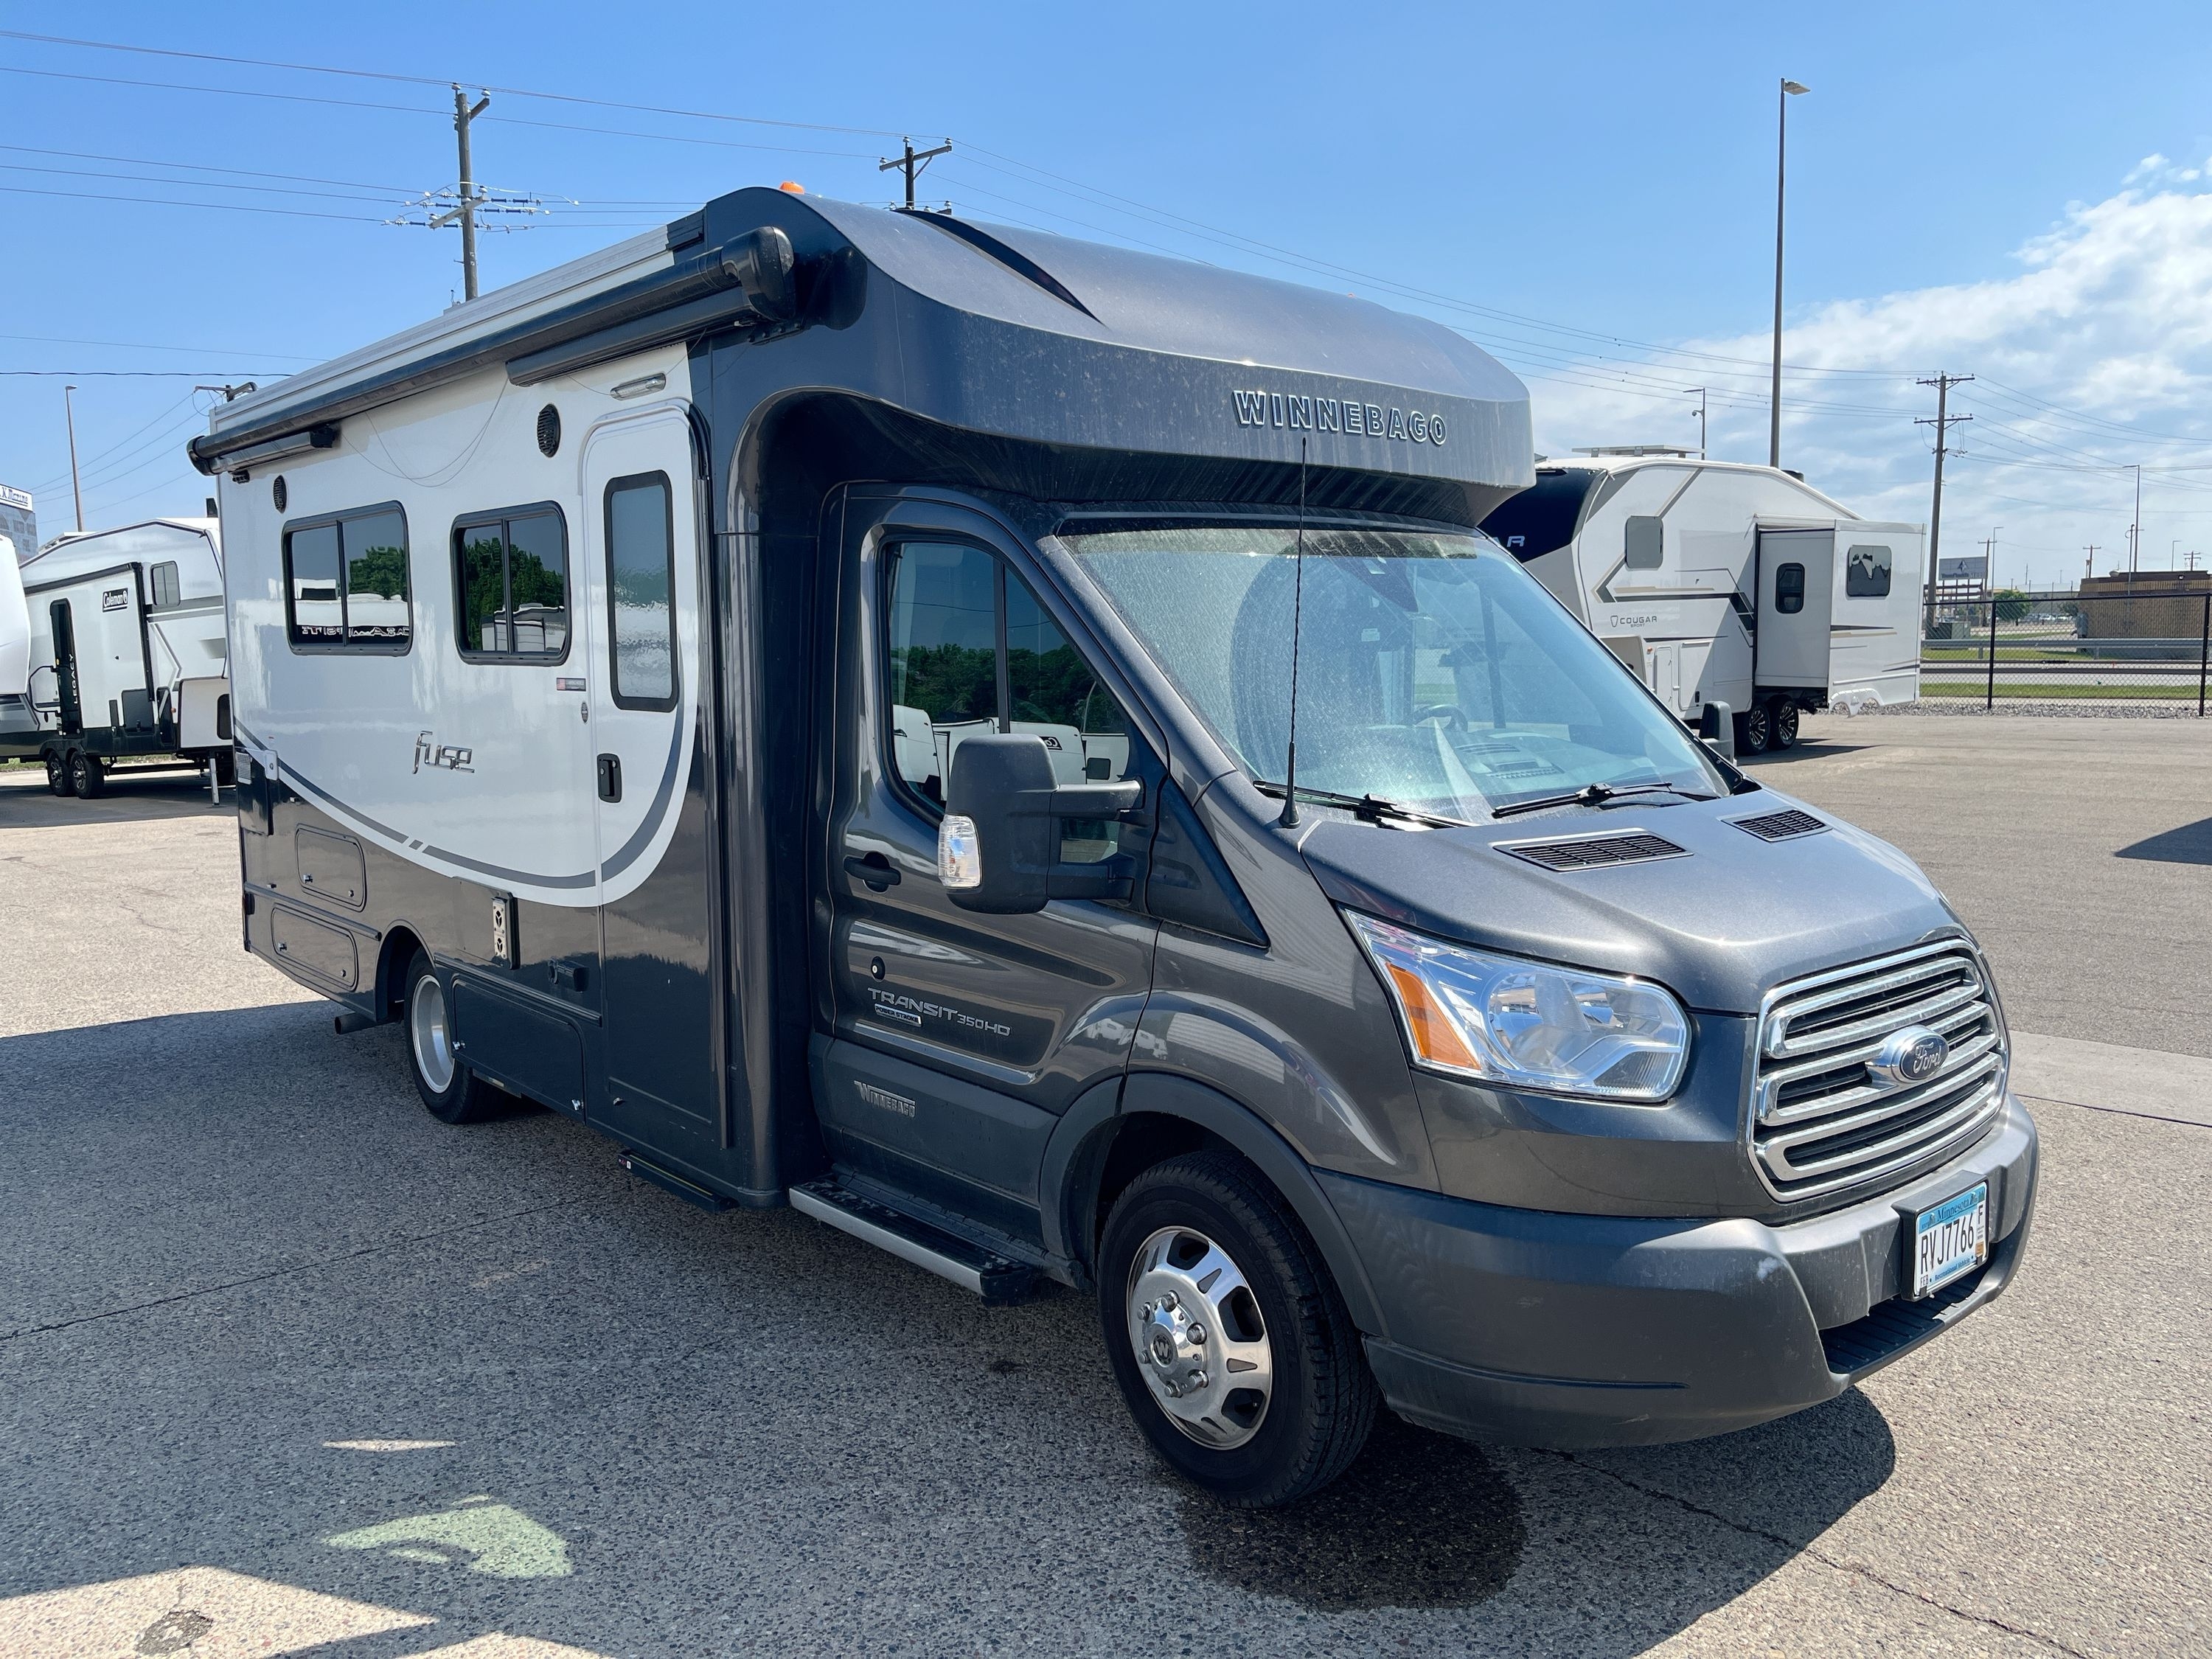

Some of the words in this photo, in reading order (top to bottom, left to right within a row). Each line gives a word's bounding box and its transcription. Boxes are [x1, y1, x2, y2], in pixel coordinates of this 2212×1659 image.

[1232, 390, 1447, 446] WINNEBAGO
[1620, 616, 1657, 625] COUGAR
[69, 653, 77, 703] LEGACY
[867, 987, 958, 1020] TRANSIT
[957, 1014, 1011, 1036] 350HD
[875, 1006, 895, 1015] POWER
[1913, 1042, 1942, 1074] Ford
[1937, 1198, 1969, 1222] Minnesota
[1921, 1212, 1974, 1275] RVJ7766
[1920, 1274, 1928, 1287] FEB
[1935, 1264, 1958, 1281] Recreational
